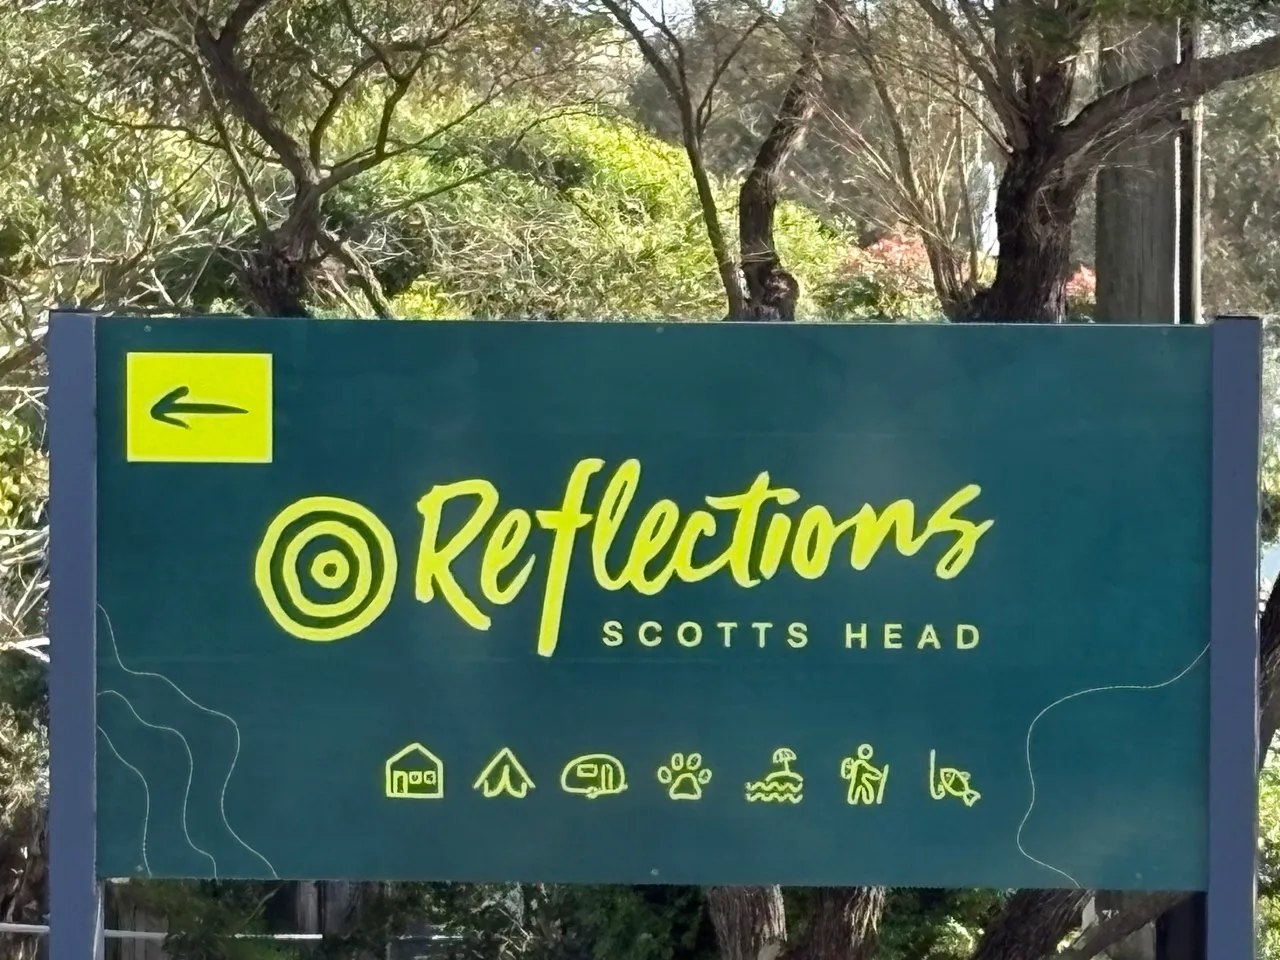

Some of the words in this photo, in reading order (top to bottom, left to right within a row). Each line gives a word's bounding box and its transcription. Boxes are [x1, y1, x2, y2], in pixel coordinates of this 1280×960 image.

[415, 458, 995, 658] Reflections
[602, 620, 809, 649] SCOTTS
[844, 622, 981, 651] HEAD
